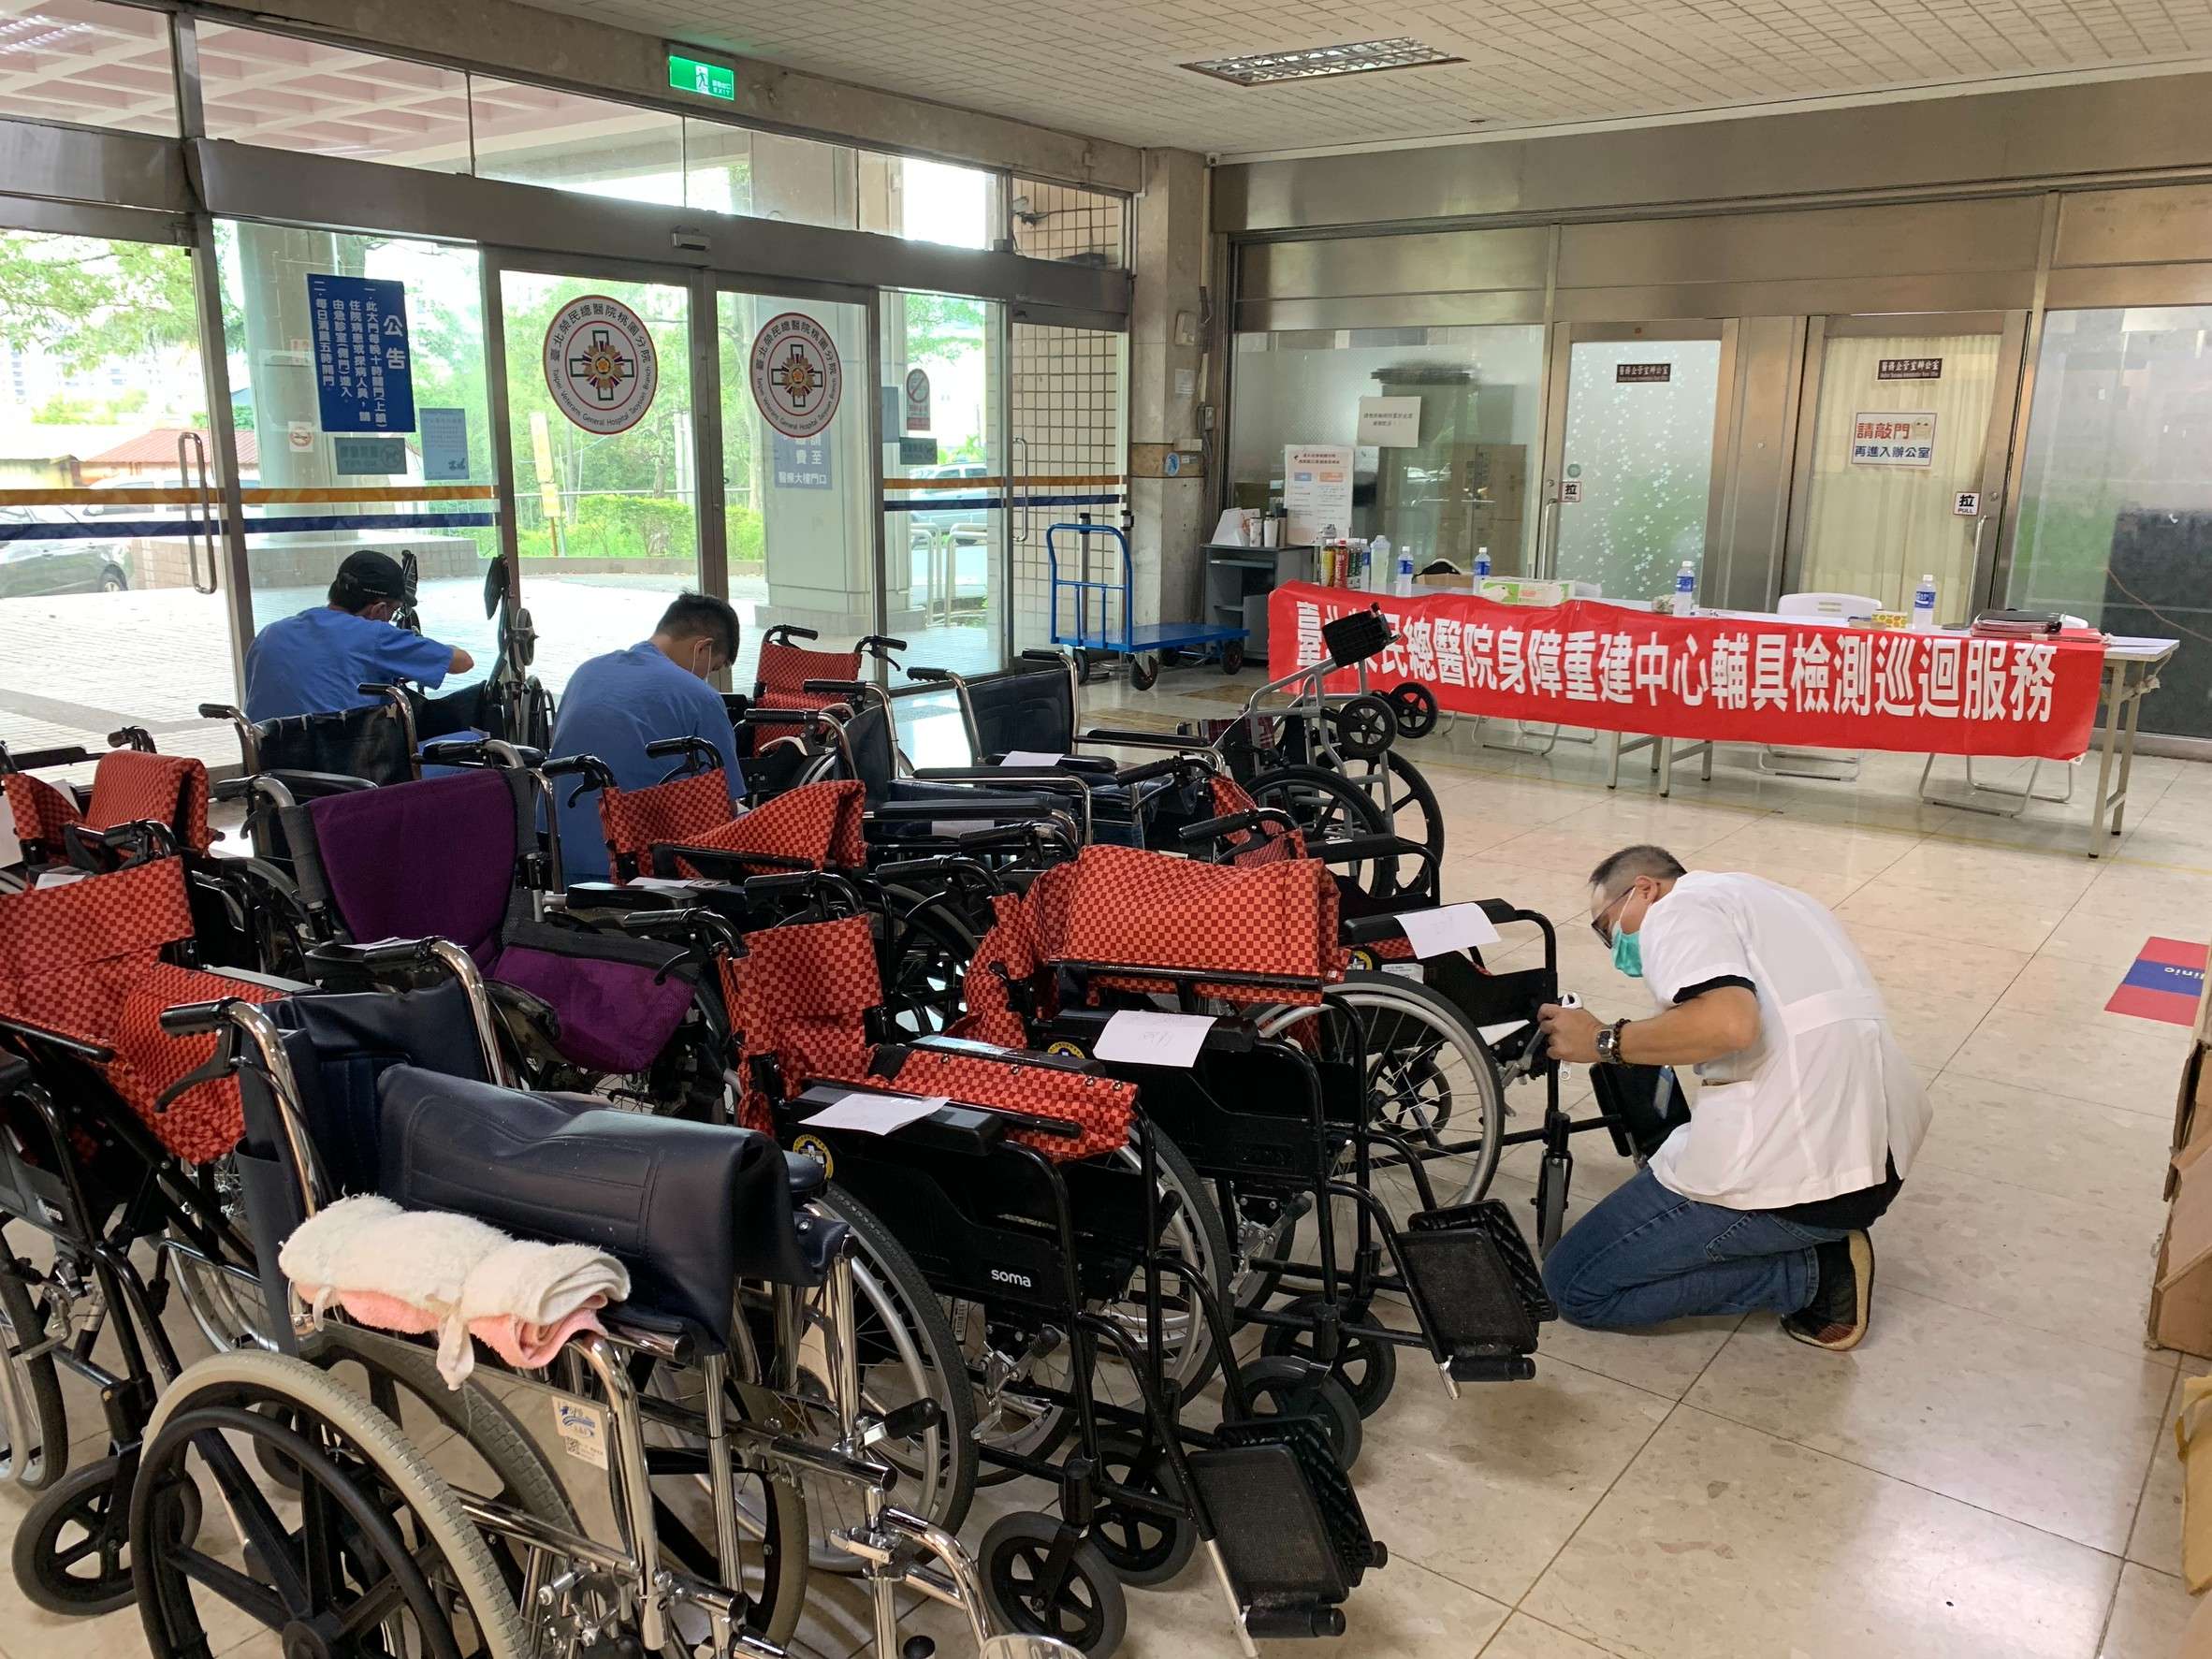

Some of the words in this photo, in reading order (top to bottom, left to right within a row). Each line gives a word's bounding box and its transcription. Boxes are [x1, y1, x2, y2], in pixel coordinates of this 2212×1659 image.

[383, 314, 406, 370] 公告
[1856, 422, 1911, 441] 請敲門
[1855, 444, 1930, 458] 再進入辦公室
[1564, 484, 1578, 495] 拉
[1958, 494, 1975, 507] 拉
[1297, 601, 2059, 723] 臺民總醫院身障重建中心輔具檢測巡迴服務
[991, 1269, 1031, 1288] soma
